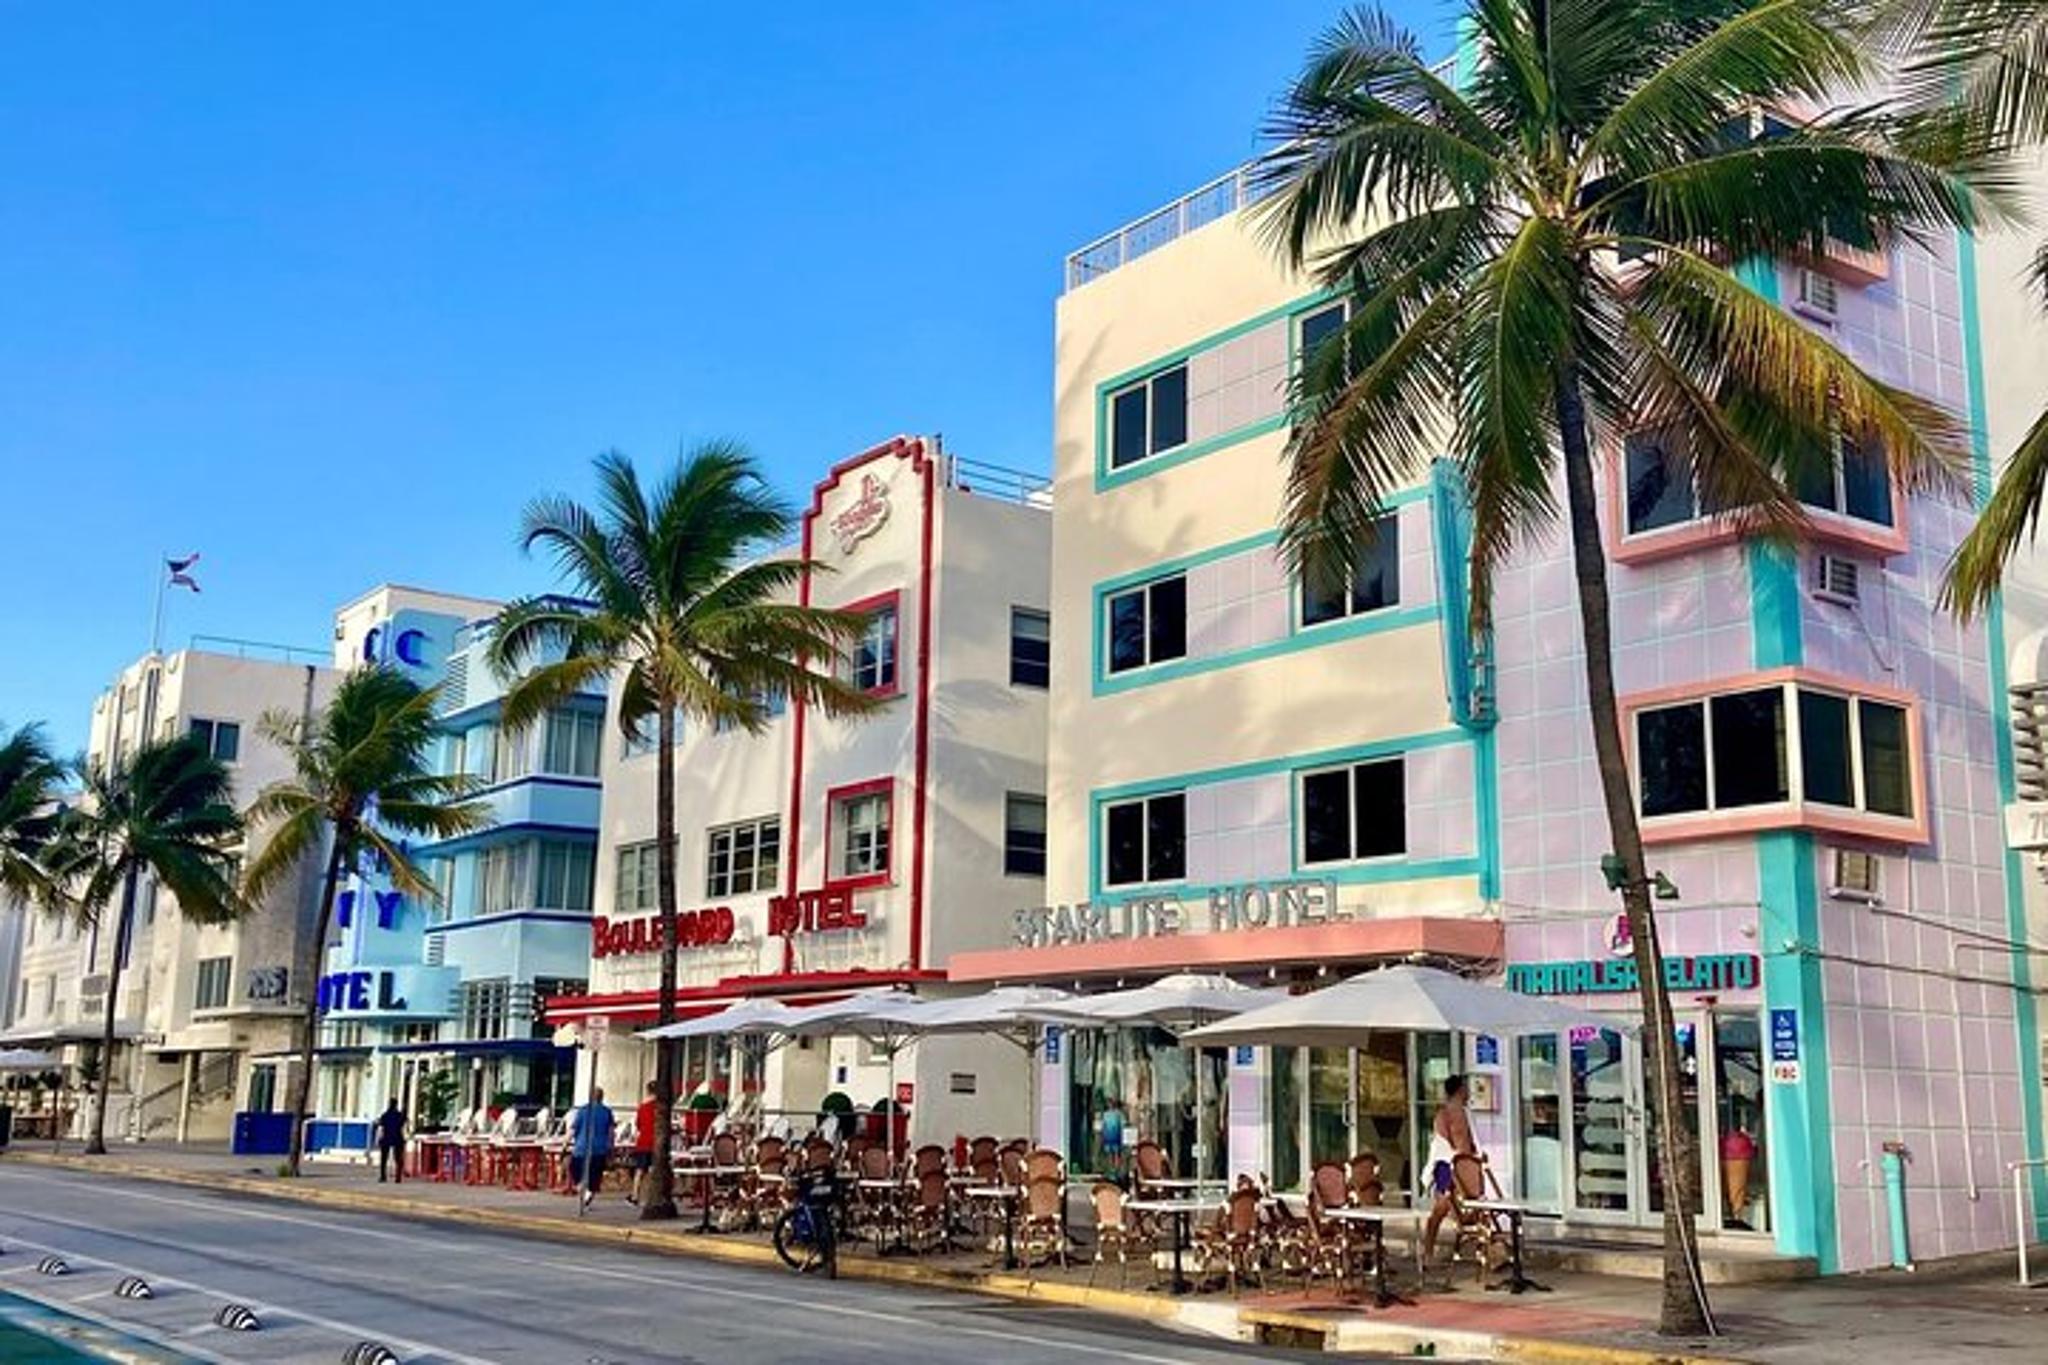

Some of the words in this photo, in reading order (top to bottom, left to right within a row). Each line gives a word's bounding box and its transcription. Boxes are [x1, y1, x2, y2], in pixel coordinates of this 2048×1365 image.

[592, 906, 735, 958] BOULEARD
[768, 890, 868, 936] HOTEL
[1012, 894, 1181, 949] STARLITE
[1208, 876, 1354, 932] HOTEL
[317, 971, 408, 1017] OTEL
[1660, 952, 1761, 990] ELATO
